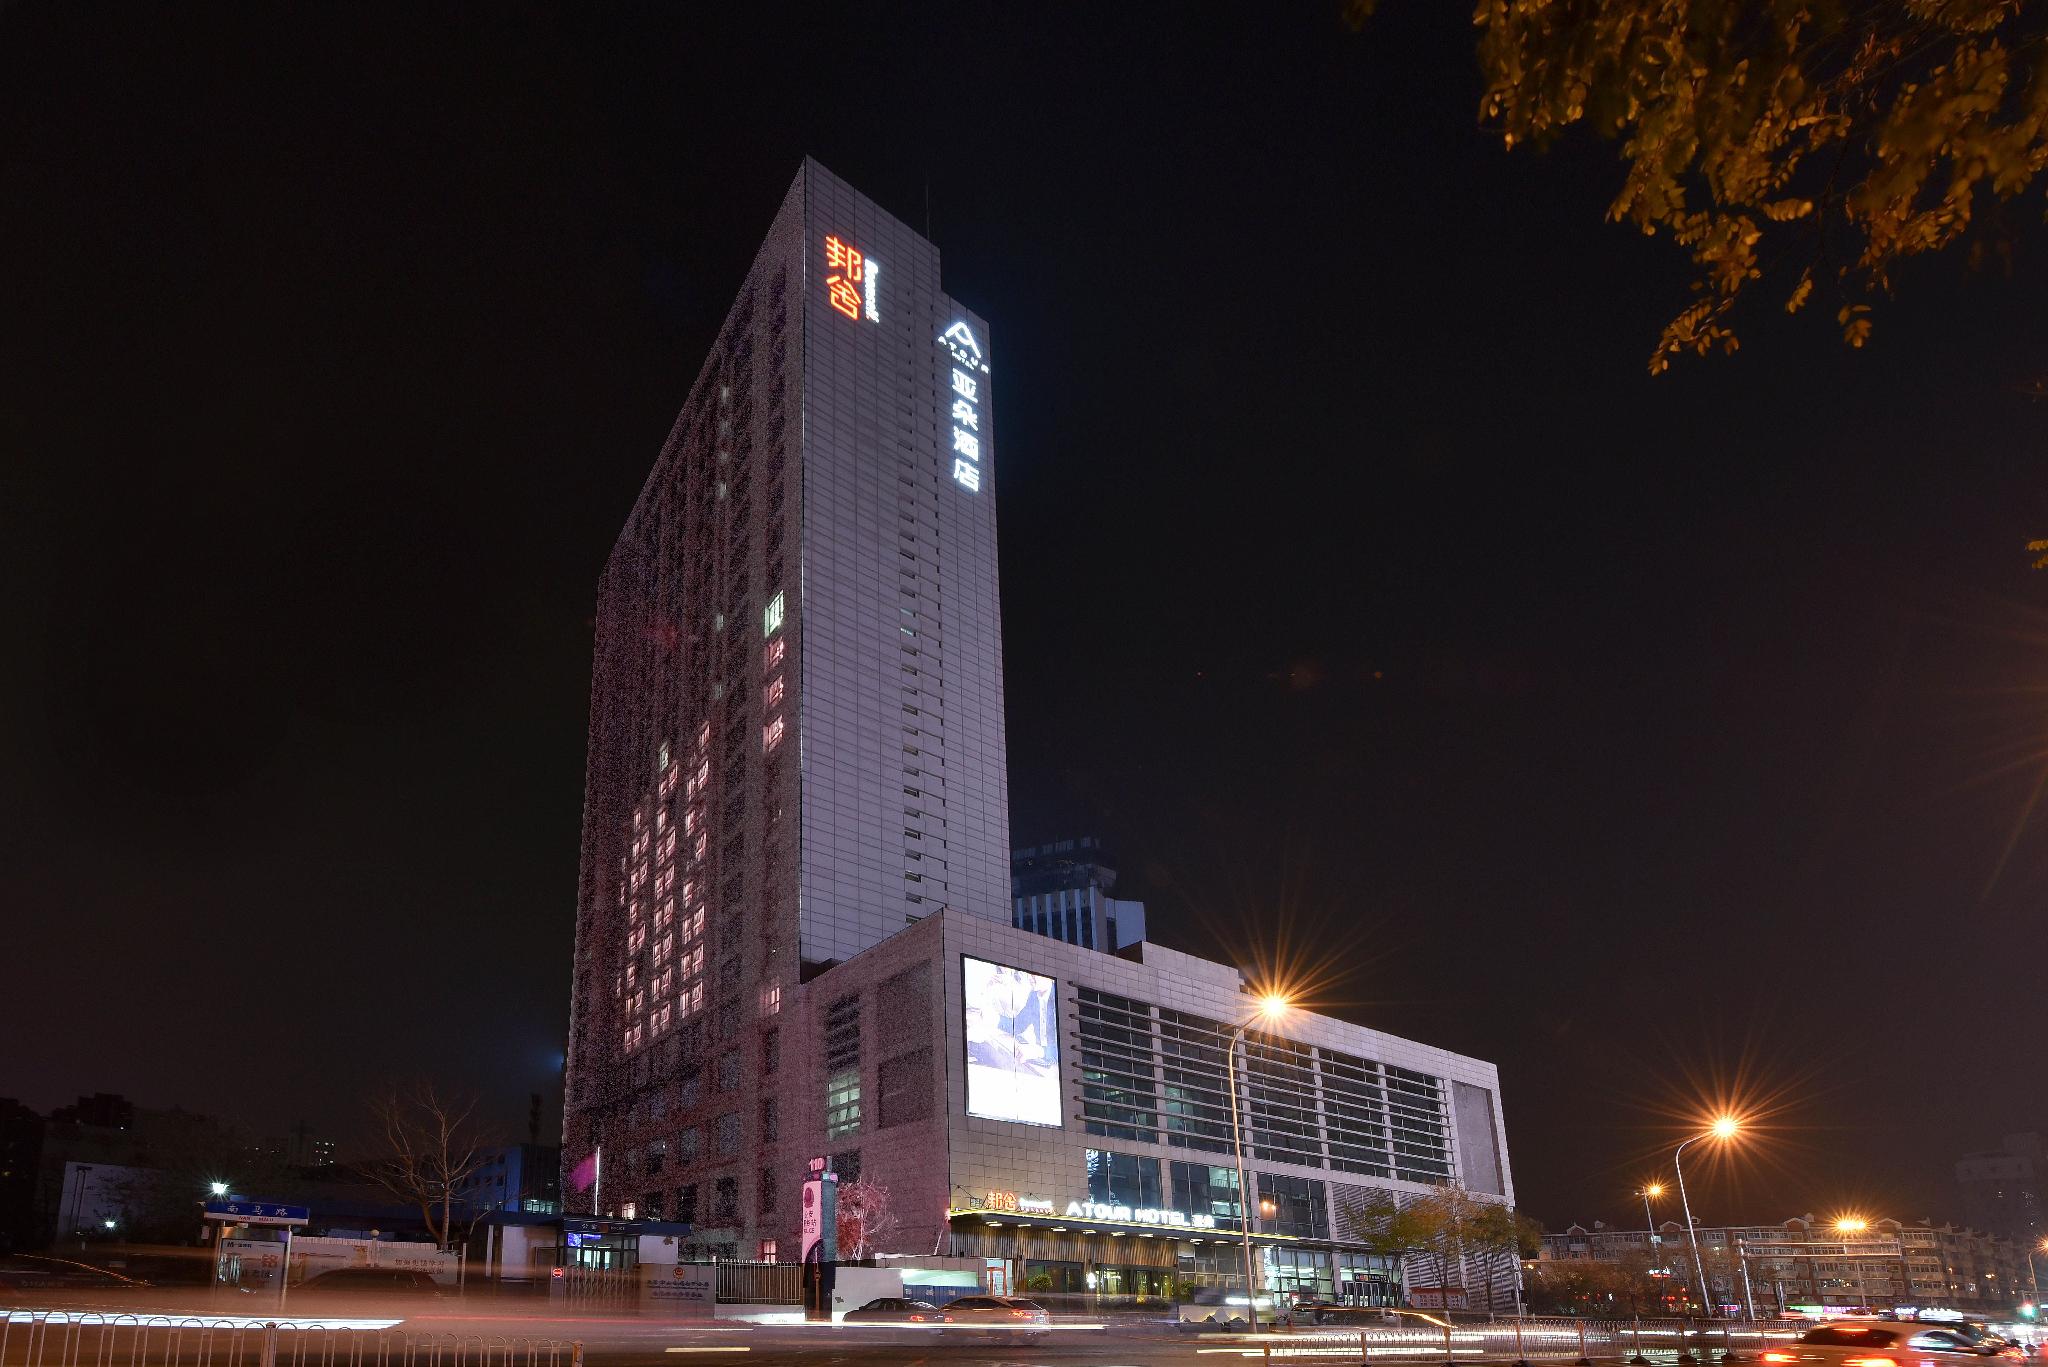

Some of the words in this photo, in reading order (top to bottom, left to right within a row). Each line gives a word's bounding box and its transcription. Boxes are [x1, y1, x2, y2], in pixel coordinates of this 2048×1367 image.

[825, 233, 863, 321] 邦舍
[951, 367, 980, 493] 亚朵酒店
[808, 1157, 825, 1172] 110
[227, 1204, 288, 1216] 南马路
[985, 1190, 1017, 1211] 邦舍
[1065, 1201, 1131, 1222] ATOUR
[1134, 1208, 1191, 1227] HOTEL
